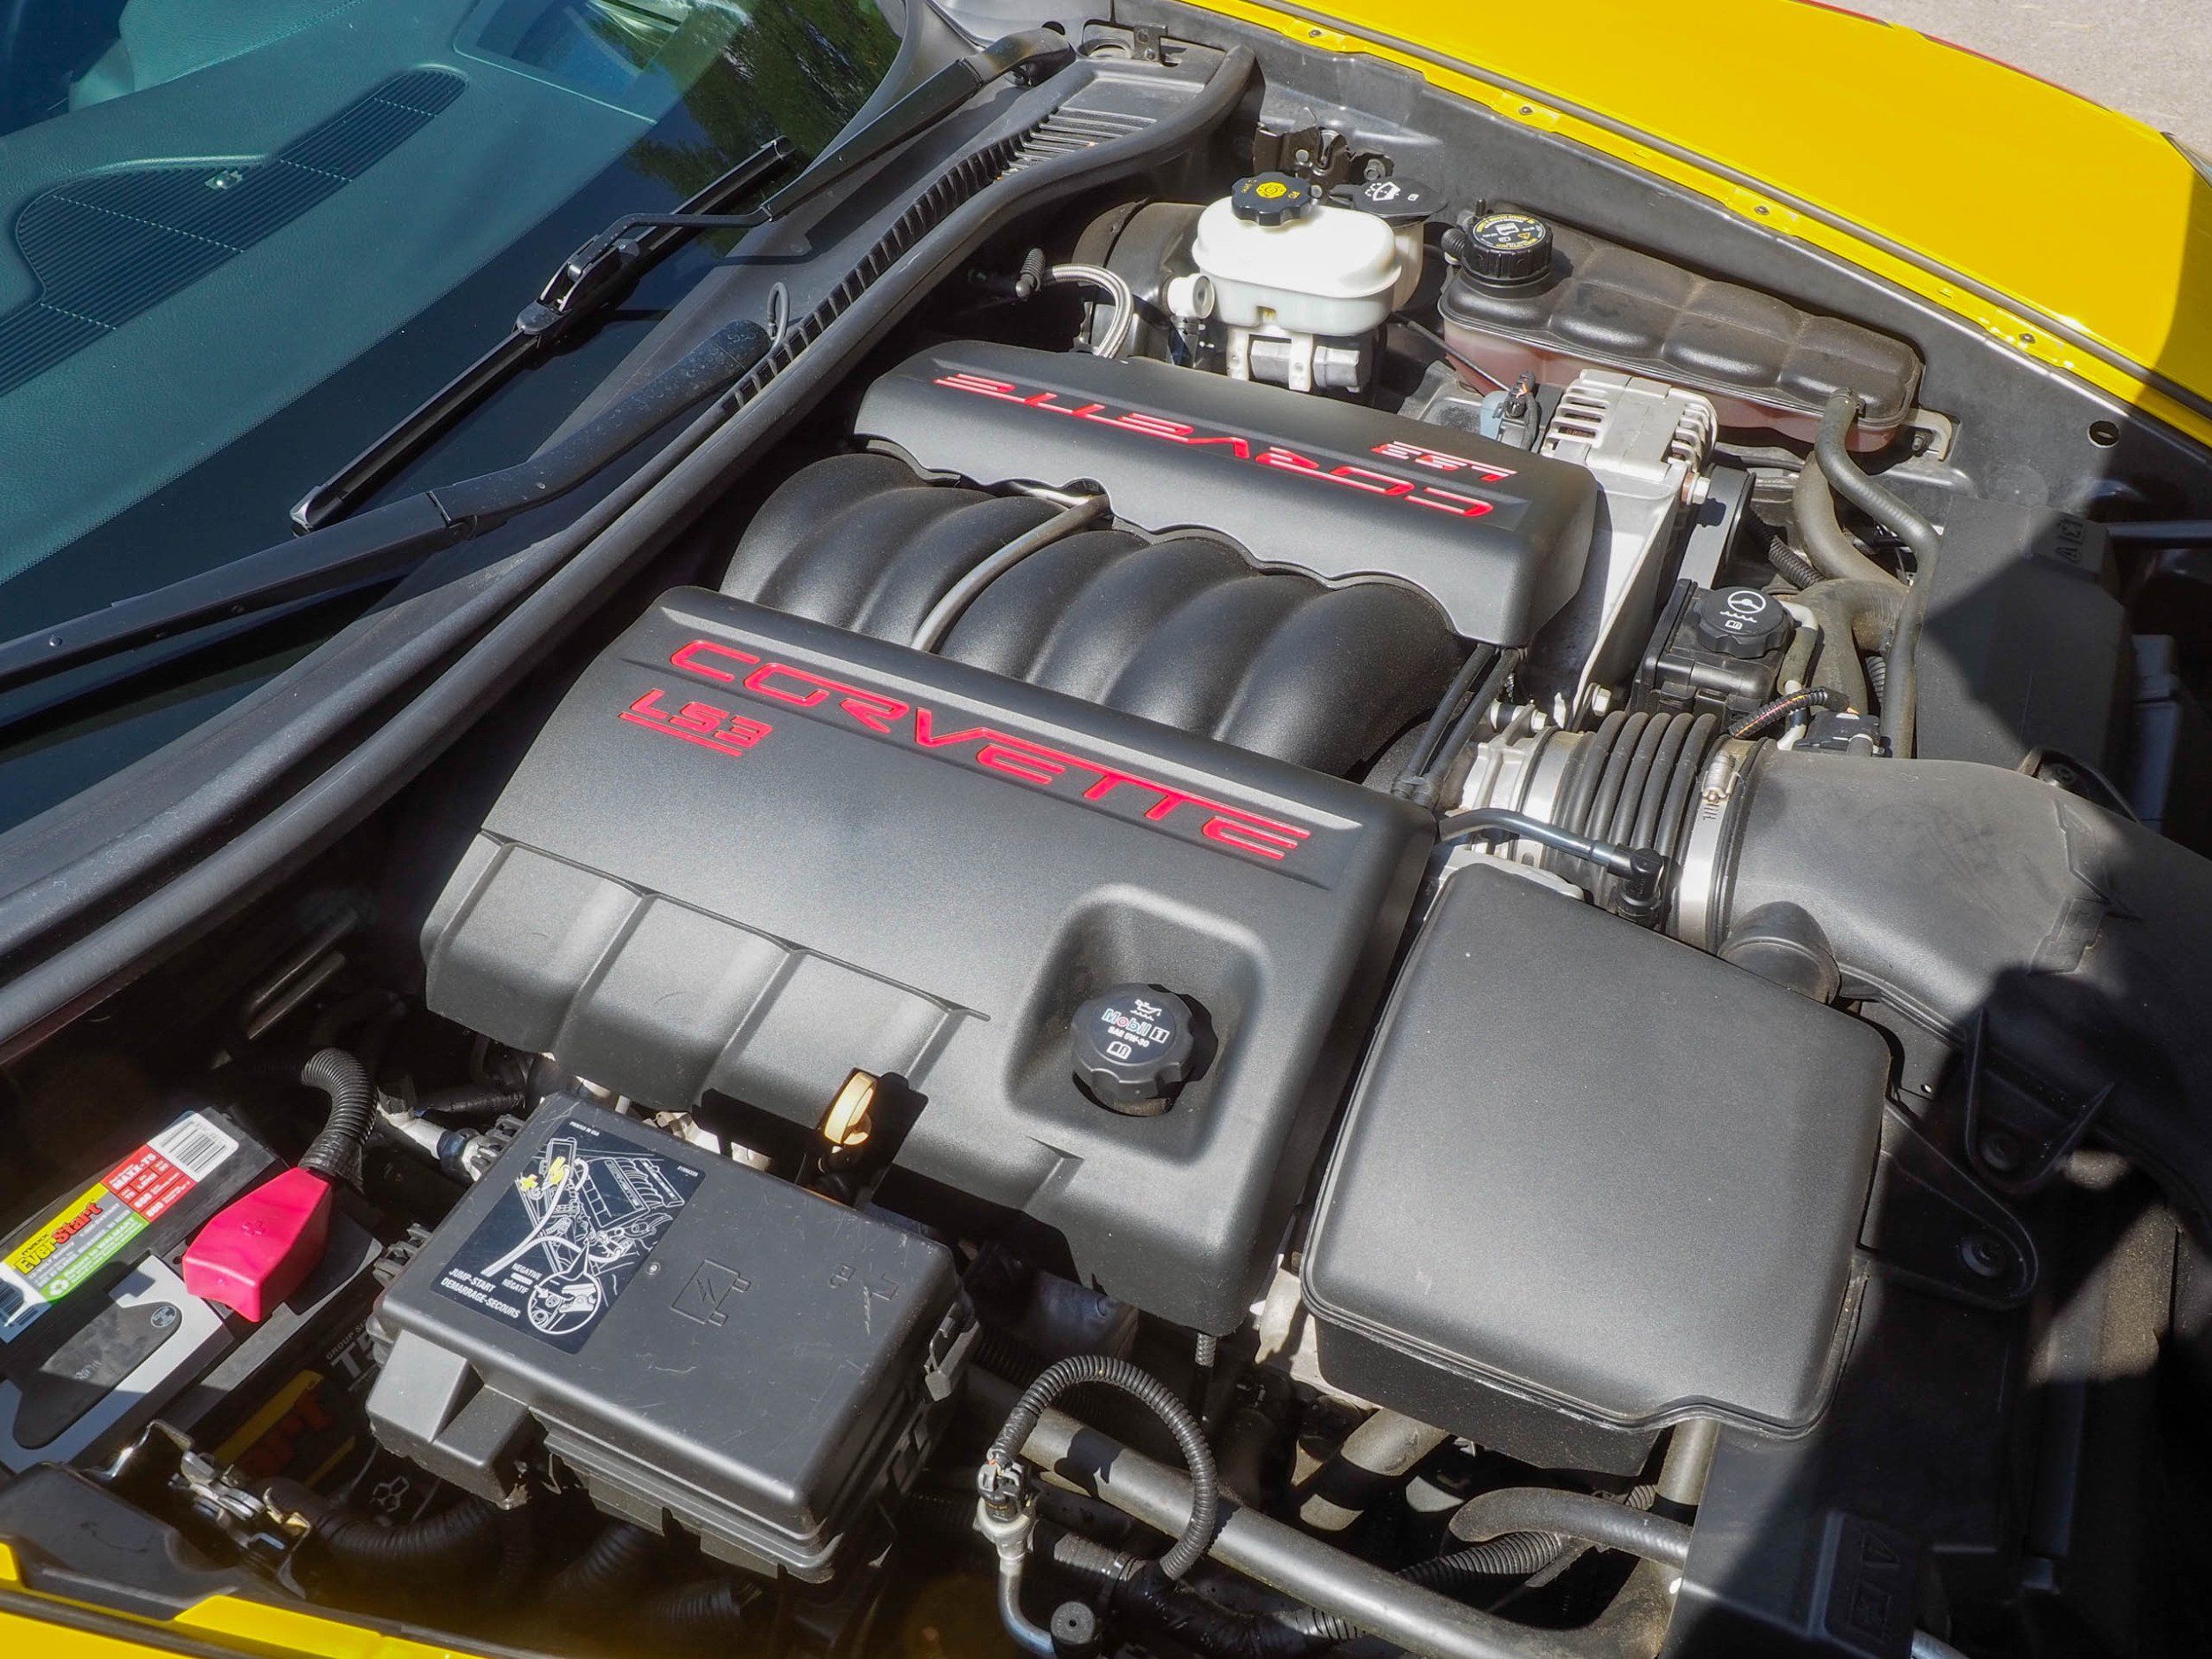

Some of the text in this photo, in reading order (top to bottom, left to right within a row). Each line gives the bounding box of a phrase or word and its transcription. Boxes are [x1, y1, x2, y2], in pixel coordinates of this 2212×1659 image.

[933, 373, 1494, 518] CORVETTE
[1372, 442, 1518, 482] LS3
[629, 688, 772, 749] LS3
[670, 639, 1310, 862] CORVETTE
[1101, 1008, 1152, 1037] Mobil
[14, 1202, 104, 1275] EverStart
[449, 1268, 496, 1293] JUMP-START
[511, 1263, 542, 1280] NEGATIVE
[441, 1277, 521, 1318] DEMARRAGE-SECOURS
